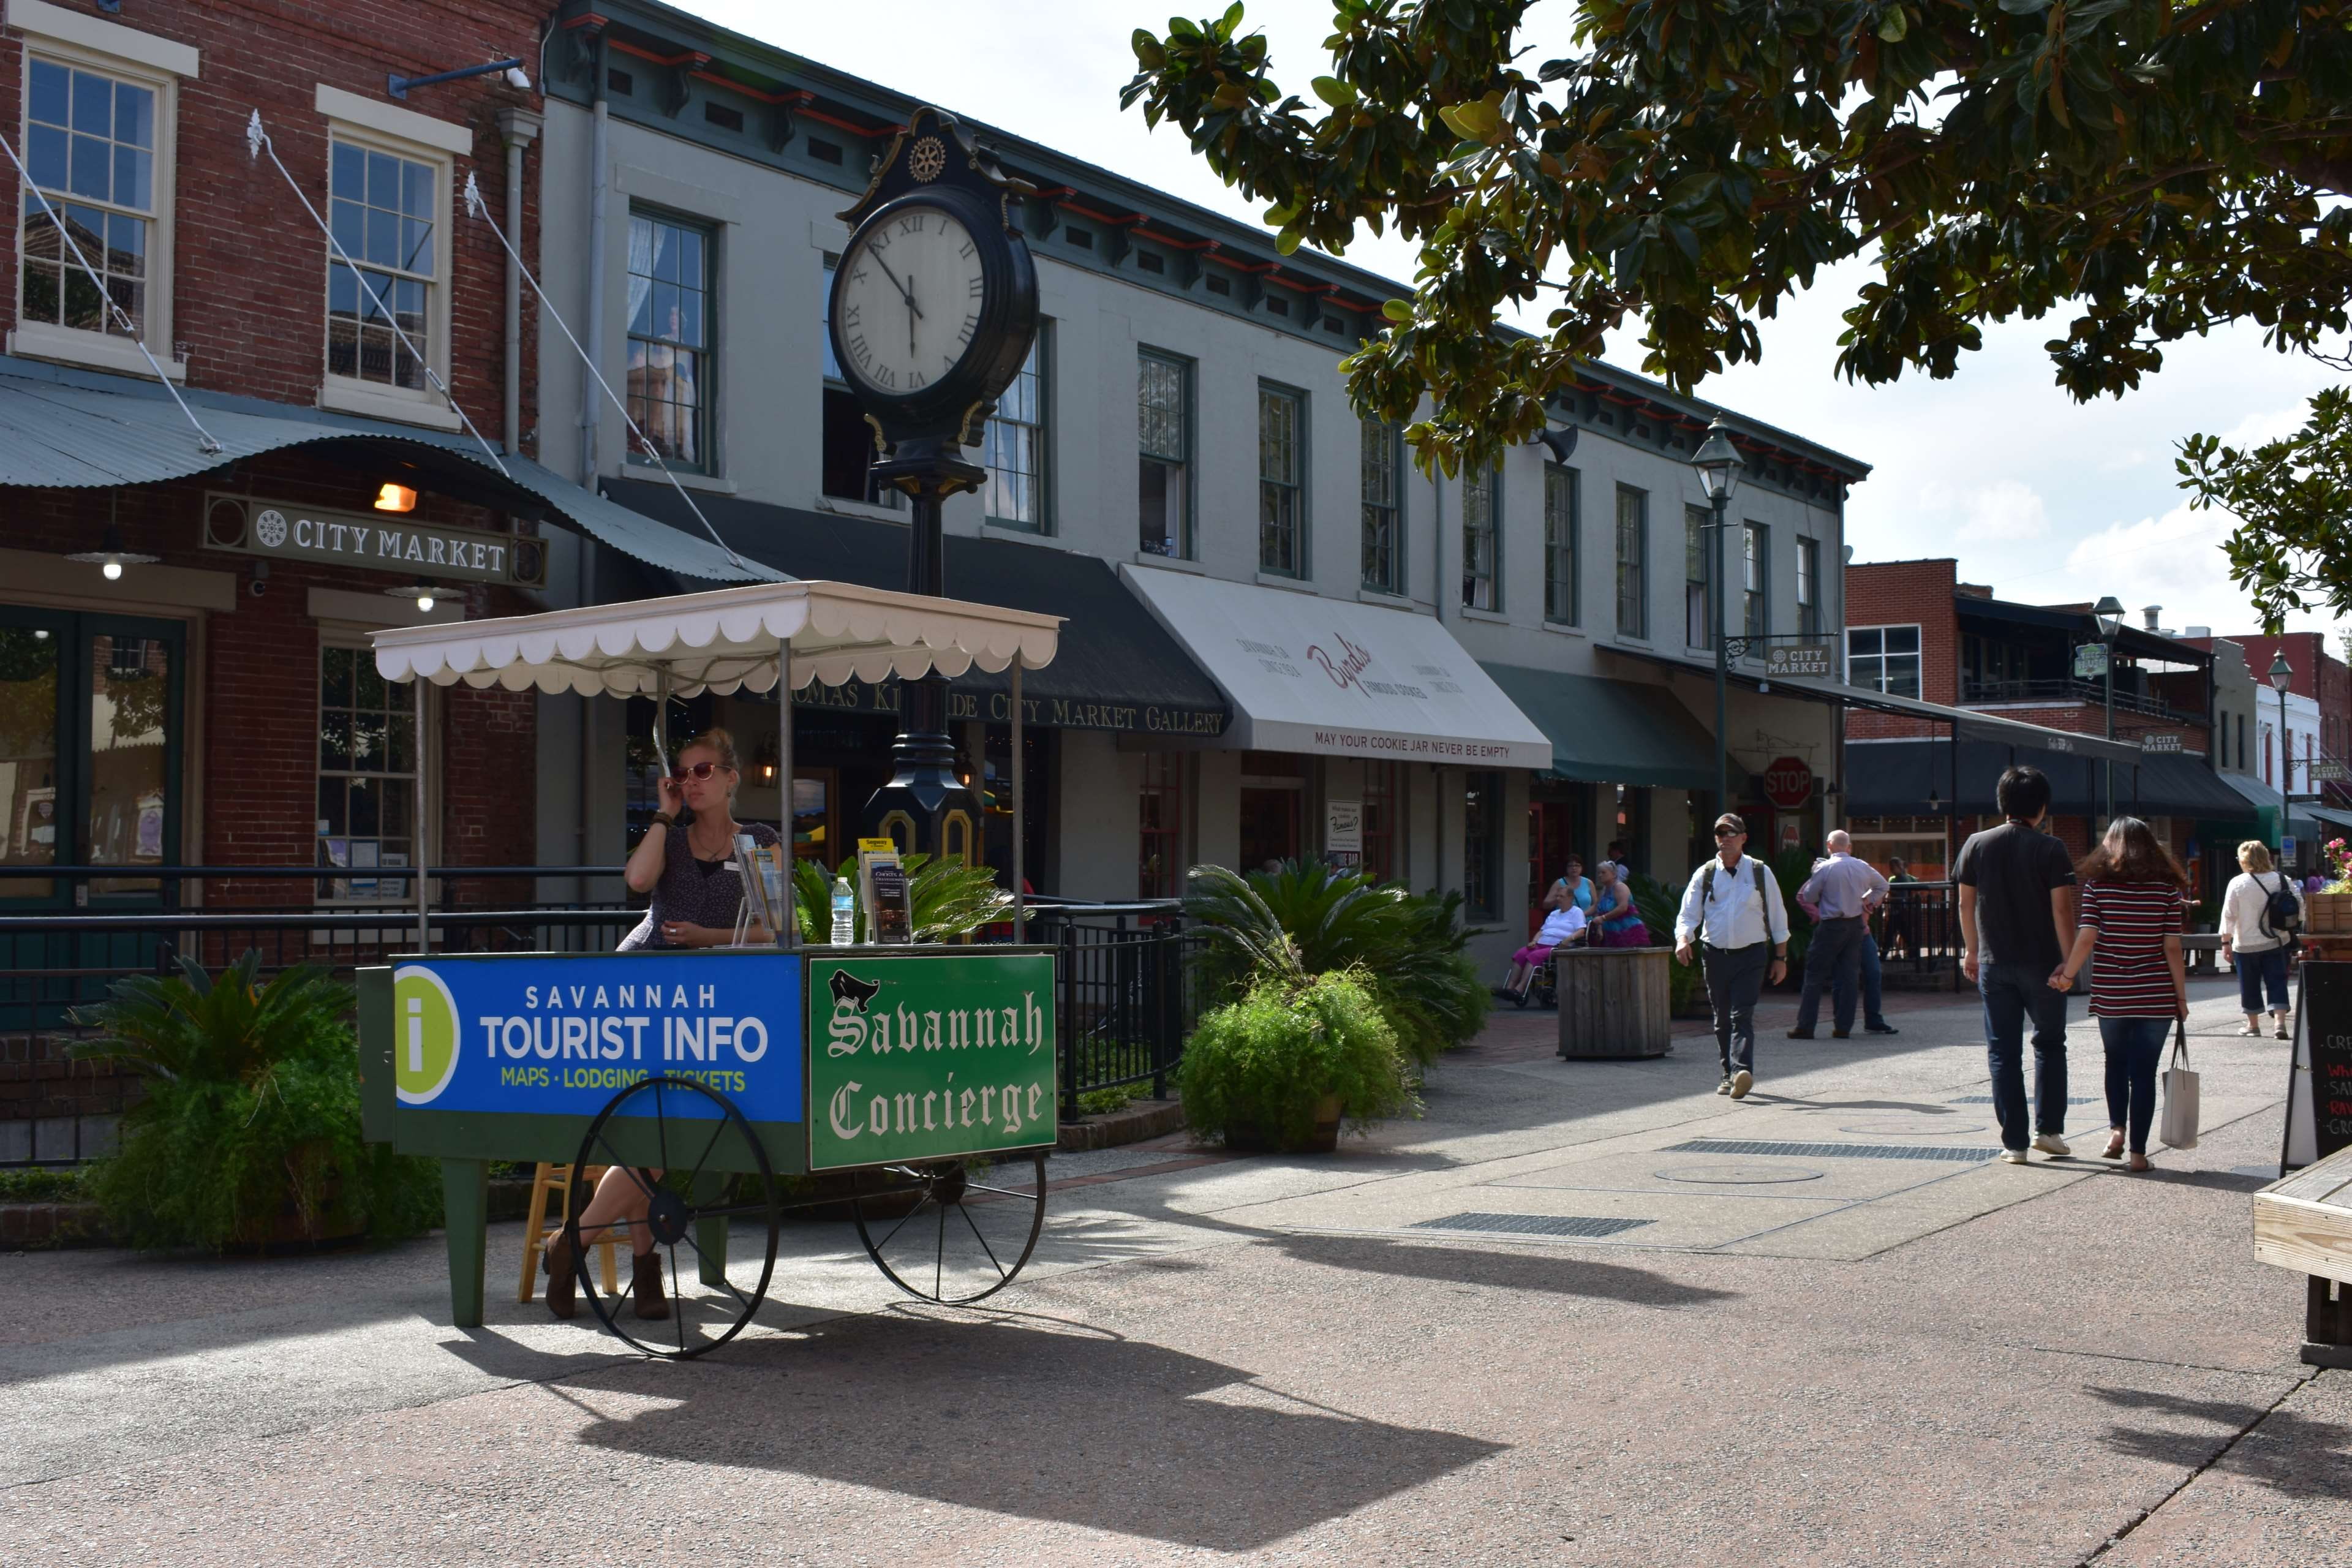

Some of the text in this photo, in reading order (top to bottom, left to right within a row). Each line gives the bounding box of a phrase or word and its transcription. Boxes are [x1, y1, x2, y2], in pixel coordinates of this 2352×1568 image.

[899, 216, 924, 236] XII
[959, 241, 976, 260] II
[853, 270, 867, 285] X
[970, 275, 983, 298] III
[850, 333, 873, 371] VIII
[874, 363, 895, 388] VII
[908, 371, 927, 389] VI
[293, 519, 505, 572] CITY MARKET
[1768, 662, 1828, 673] MARKET
[1790, 650, 1823, 661] CITY
[1052, 699, 1137, 729] MARKET
[1145, 706, 1224, 734] GALLERY
[1315, 732, 1510, 758] MAY YOUR COOKIE JAR NEVER BE EMPTY
[1767, 770, 1810, 793] STOP
[525, 984, 715, 1009] SAVANNAH
[827, 991, 1042, 1058] Savannah
[480, 1016, 769, 1063] TOURIST INFO
[500, 1066, 746, 1092] MAPS LODGING TICKETS
[829, 1072, 1042, 1140] Concierge
